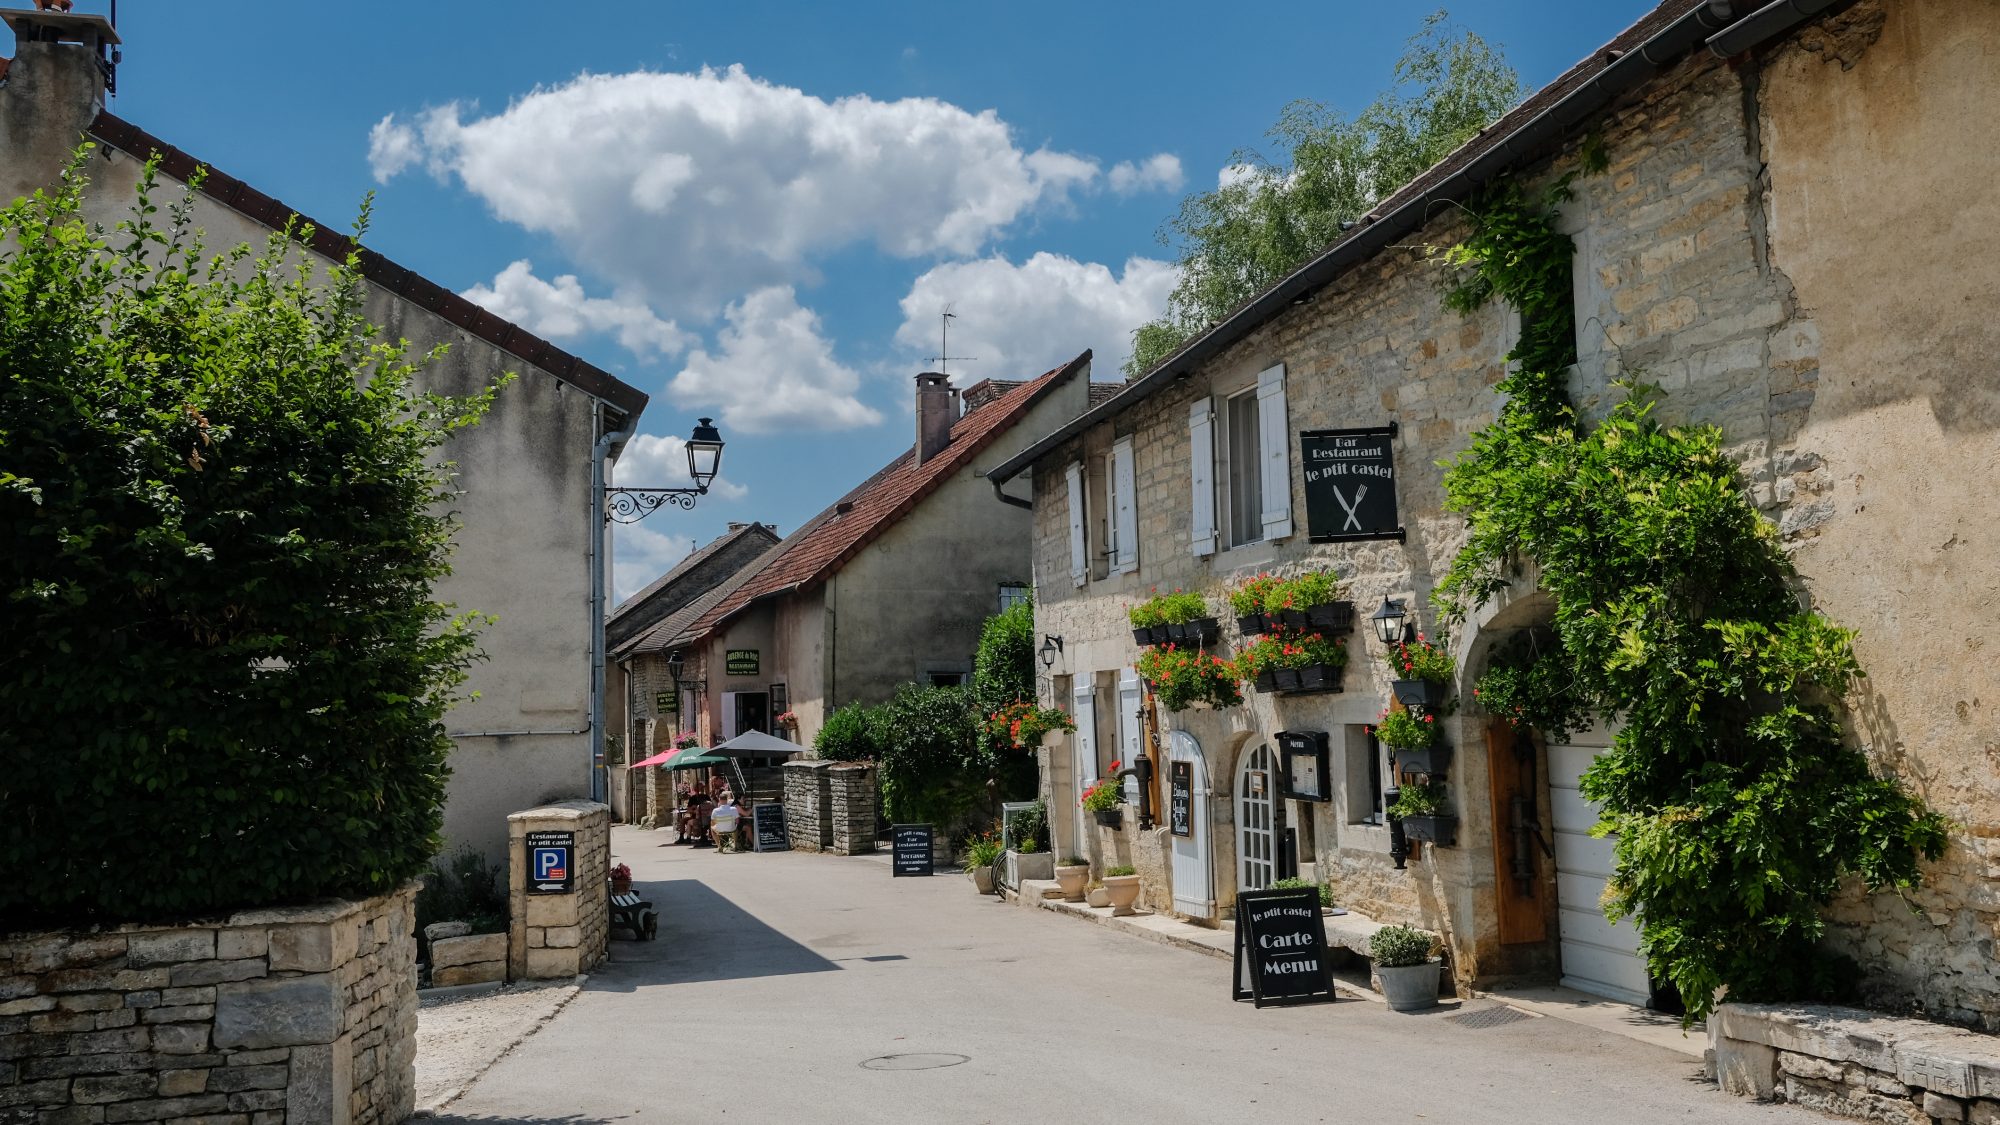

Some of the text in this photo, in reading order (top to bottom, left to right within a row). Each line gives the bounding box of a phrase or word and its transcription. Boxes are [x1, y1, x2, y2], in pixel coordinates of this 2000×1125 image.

[1335, 438, 1358, 447] Bar
[1312, 446, 1383, 459] Restaurant
[1305, 462, 1392, 482] le ptit castel
[1290, 740, 1305, 748] Menu
[542, 852, 559, 876] P
[1252, 907, 1312, 922] le ptit castel
[1260, 931, 1313, 949] Carte
[1263, 959, 1318, 976] Menu
